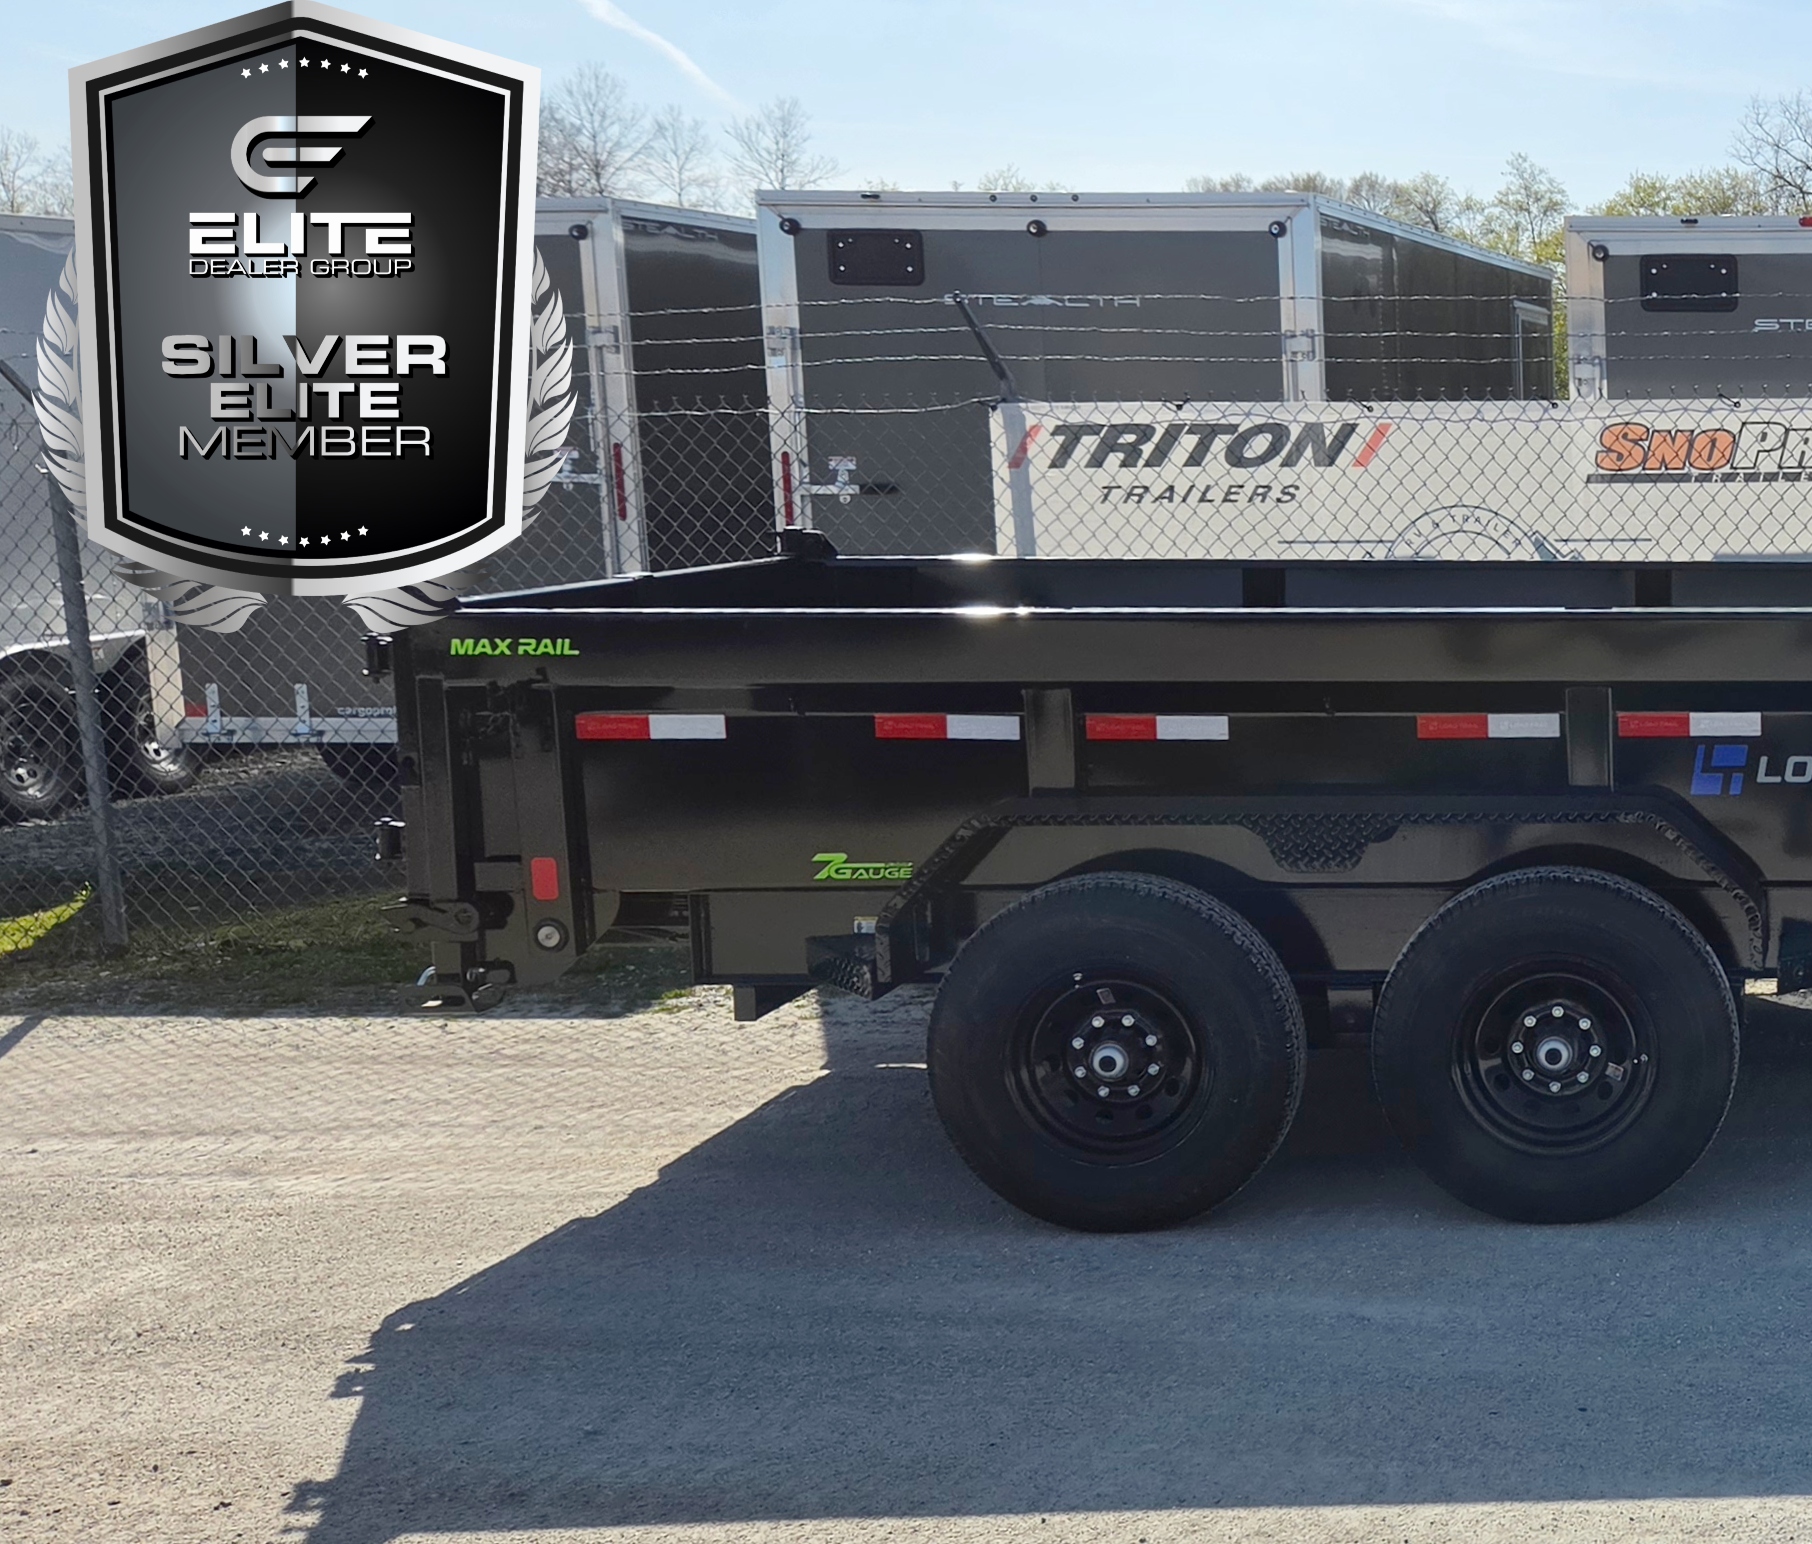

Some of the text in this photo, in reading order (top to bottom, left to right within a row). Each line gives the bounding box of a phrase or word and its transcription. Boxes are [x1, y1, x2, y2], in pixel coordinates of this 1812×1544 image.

[1047, 422, 1361, 469] TRITON
[1100, 484, 1301, 504] TRAILERS
[450, 637, 581, 656] MAX RAIL
